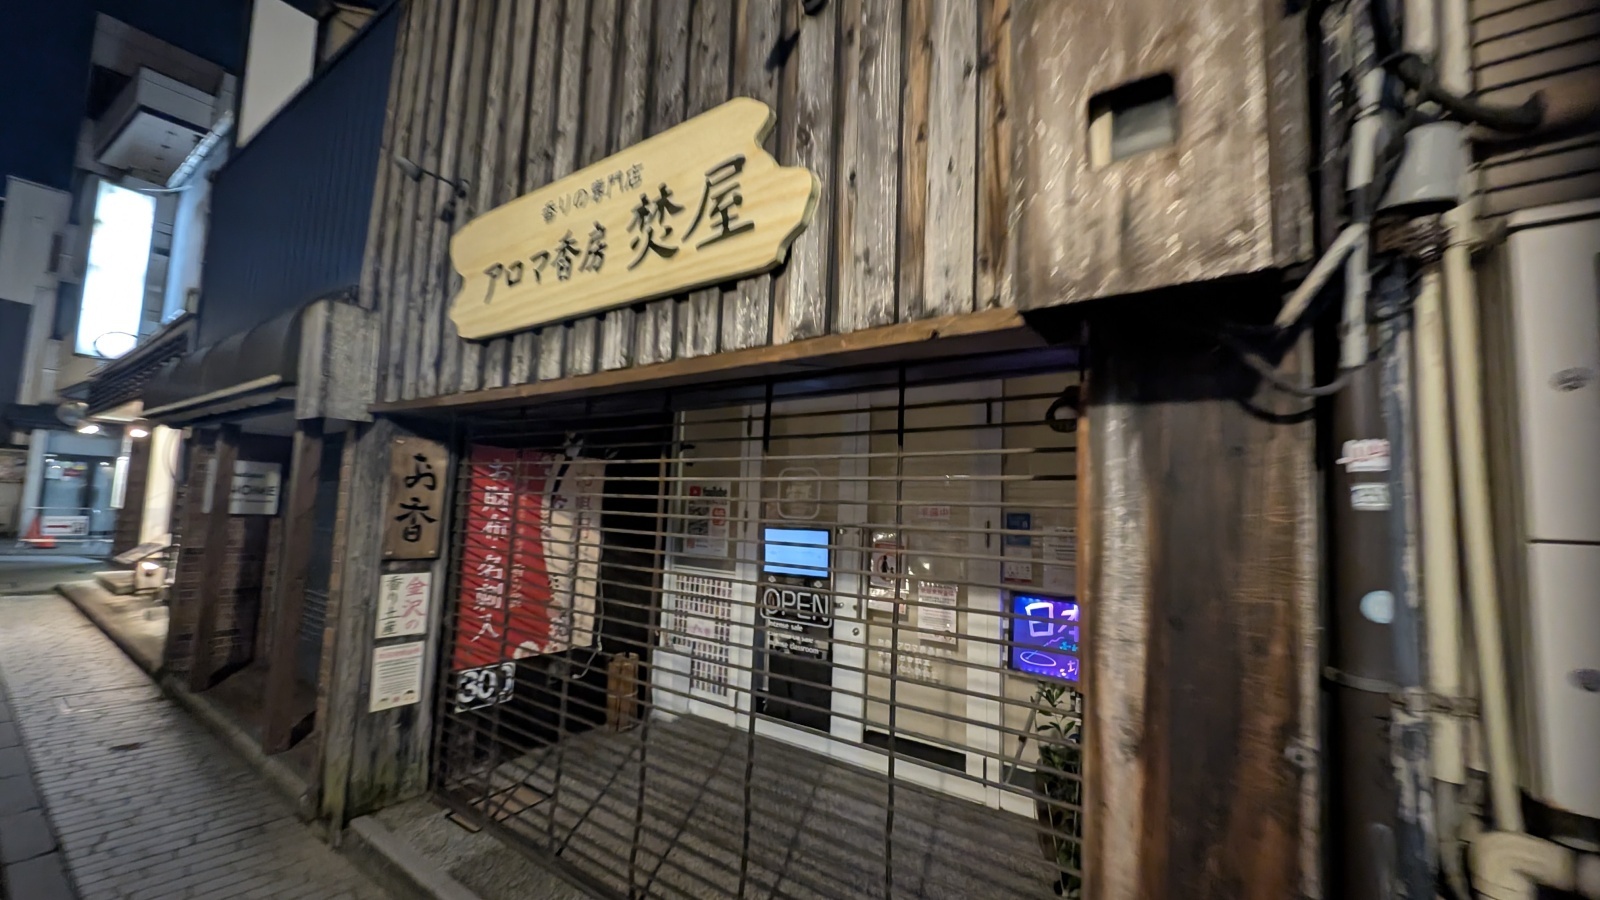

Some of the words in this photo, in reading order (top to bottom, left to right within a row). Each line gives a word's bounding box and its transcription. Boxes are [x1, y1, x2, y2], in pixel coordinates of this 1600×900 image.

[541, 162, 645, 226] 香りの専門店
[482, 220, 609, 304] アロマ香房
[626, 153, 755, 271] 焚屋
[395, 453, 439, 543] お香
[402, 575, 429, 631] 金沢の
[763, 588, 829, 622] OPEN
